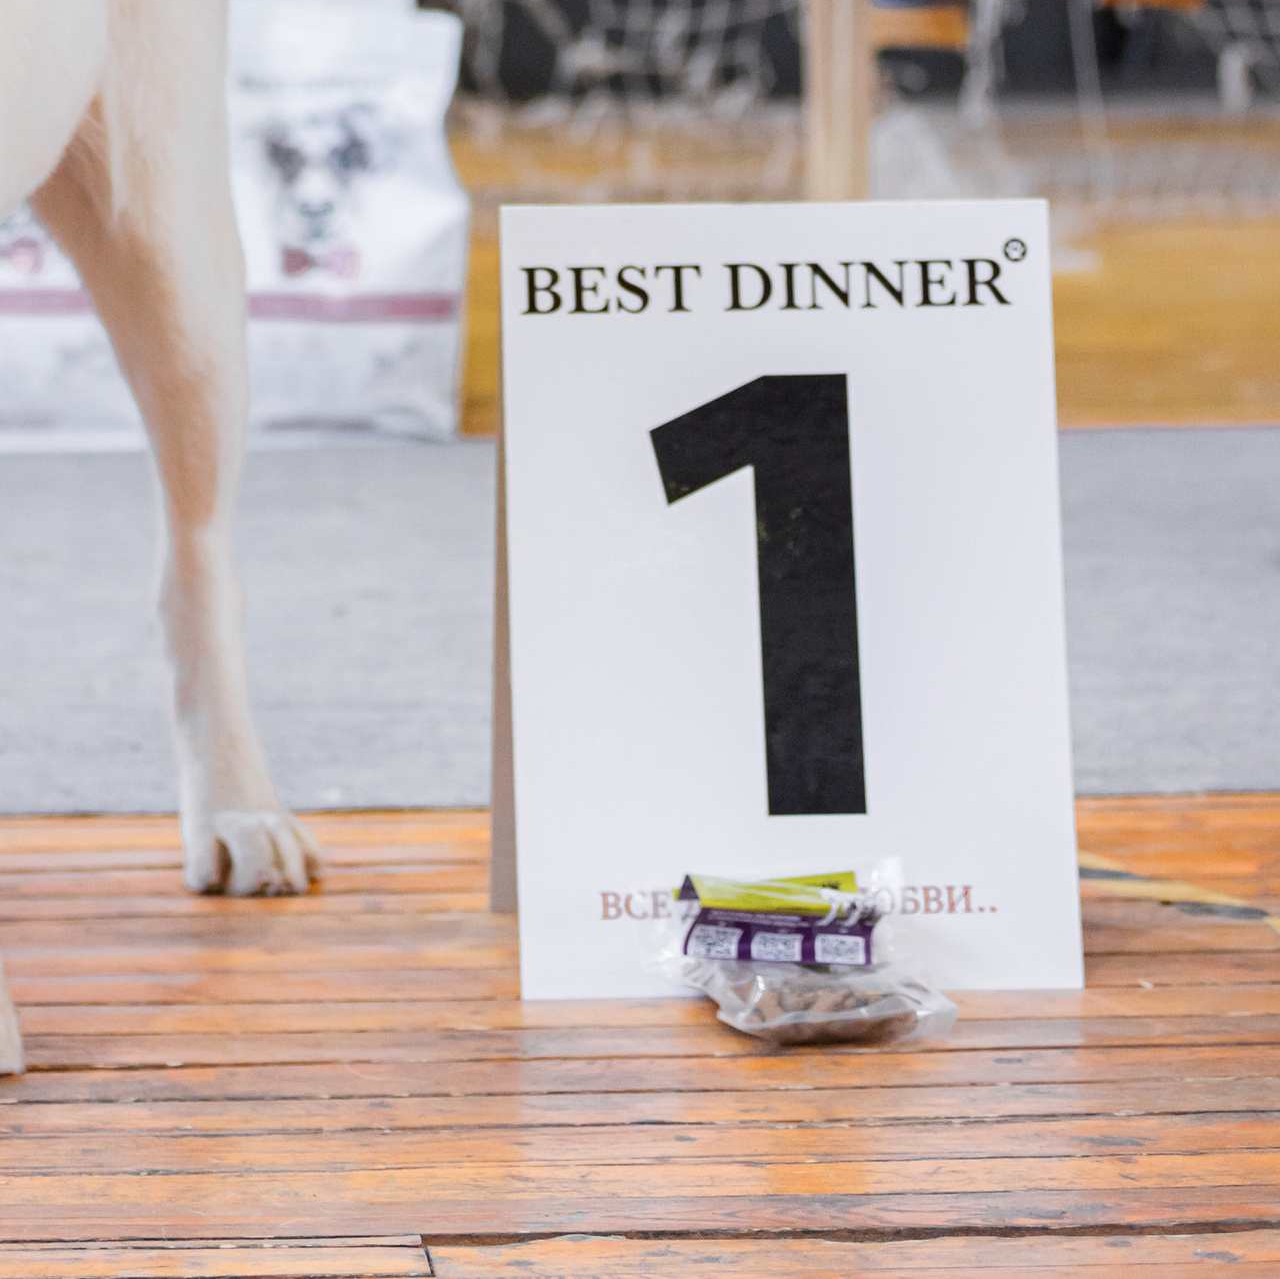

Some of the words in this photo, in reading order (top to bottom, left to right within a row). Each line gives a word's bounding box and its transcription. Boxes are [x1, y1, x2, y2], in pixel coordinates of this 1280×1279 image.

[521, 263, 701, 315] BEST
[724, 257, 1012, 312] DINNER
[649, 373, 867, 816] 1
[600, 889, 673, 921] ВСЕ
